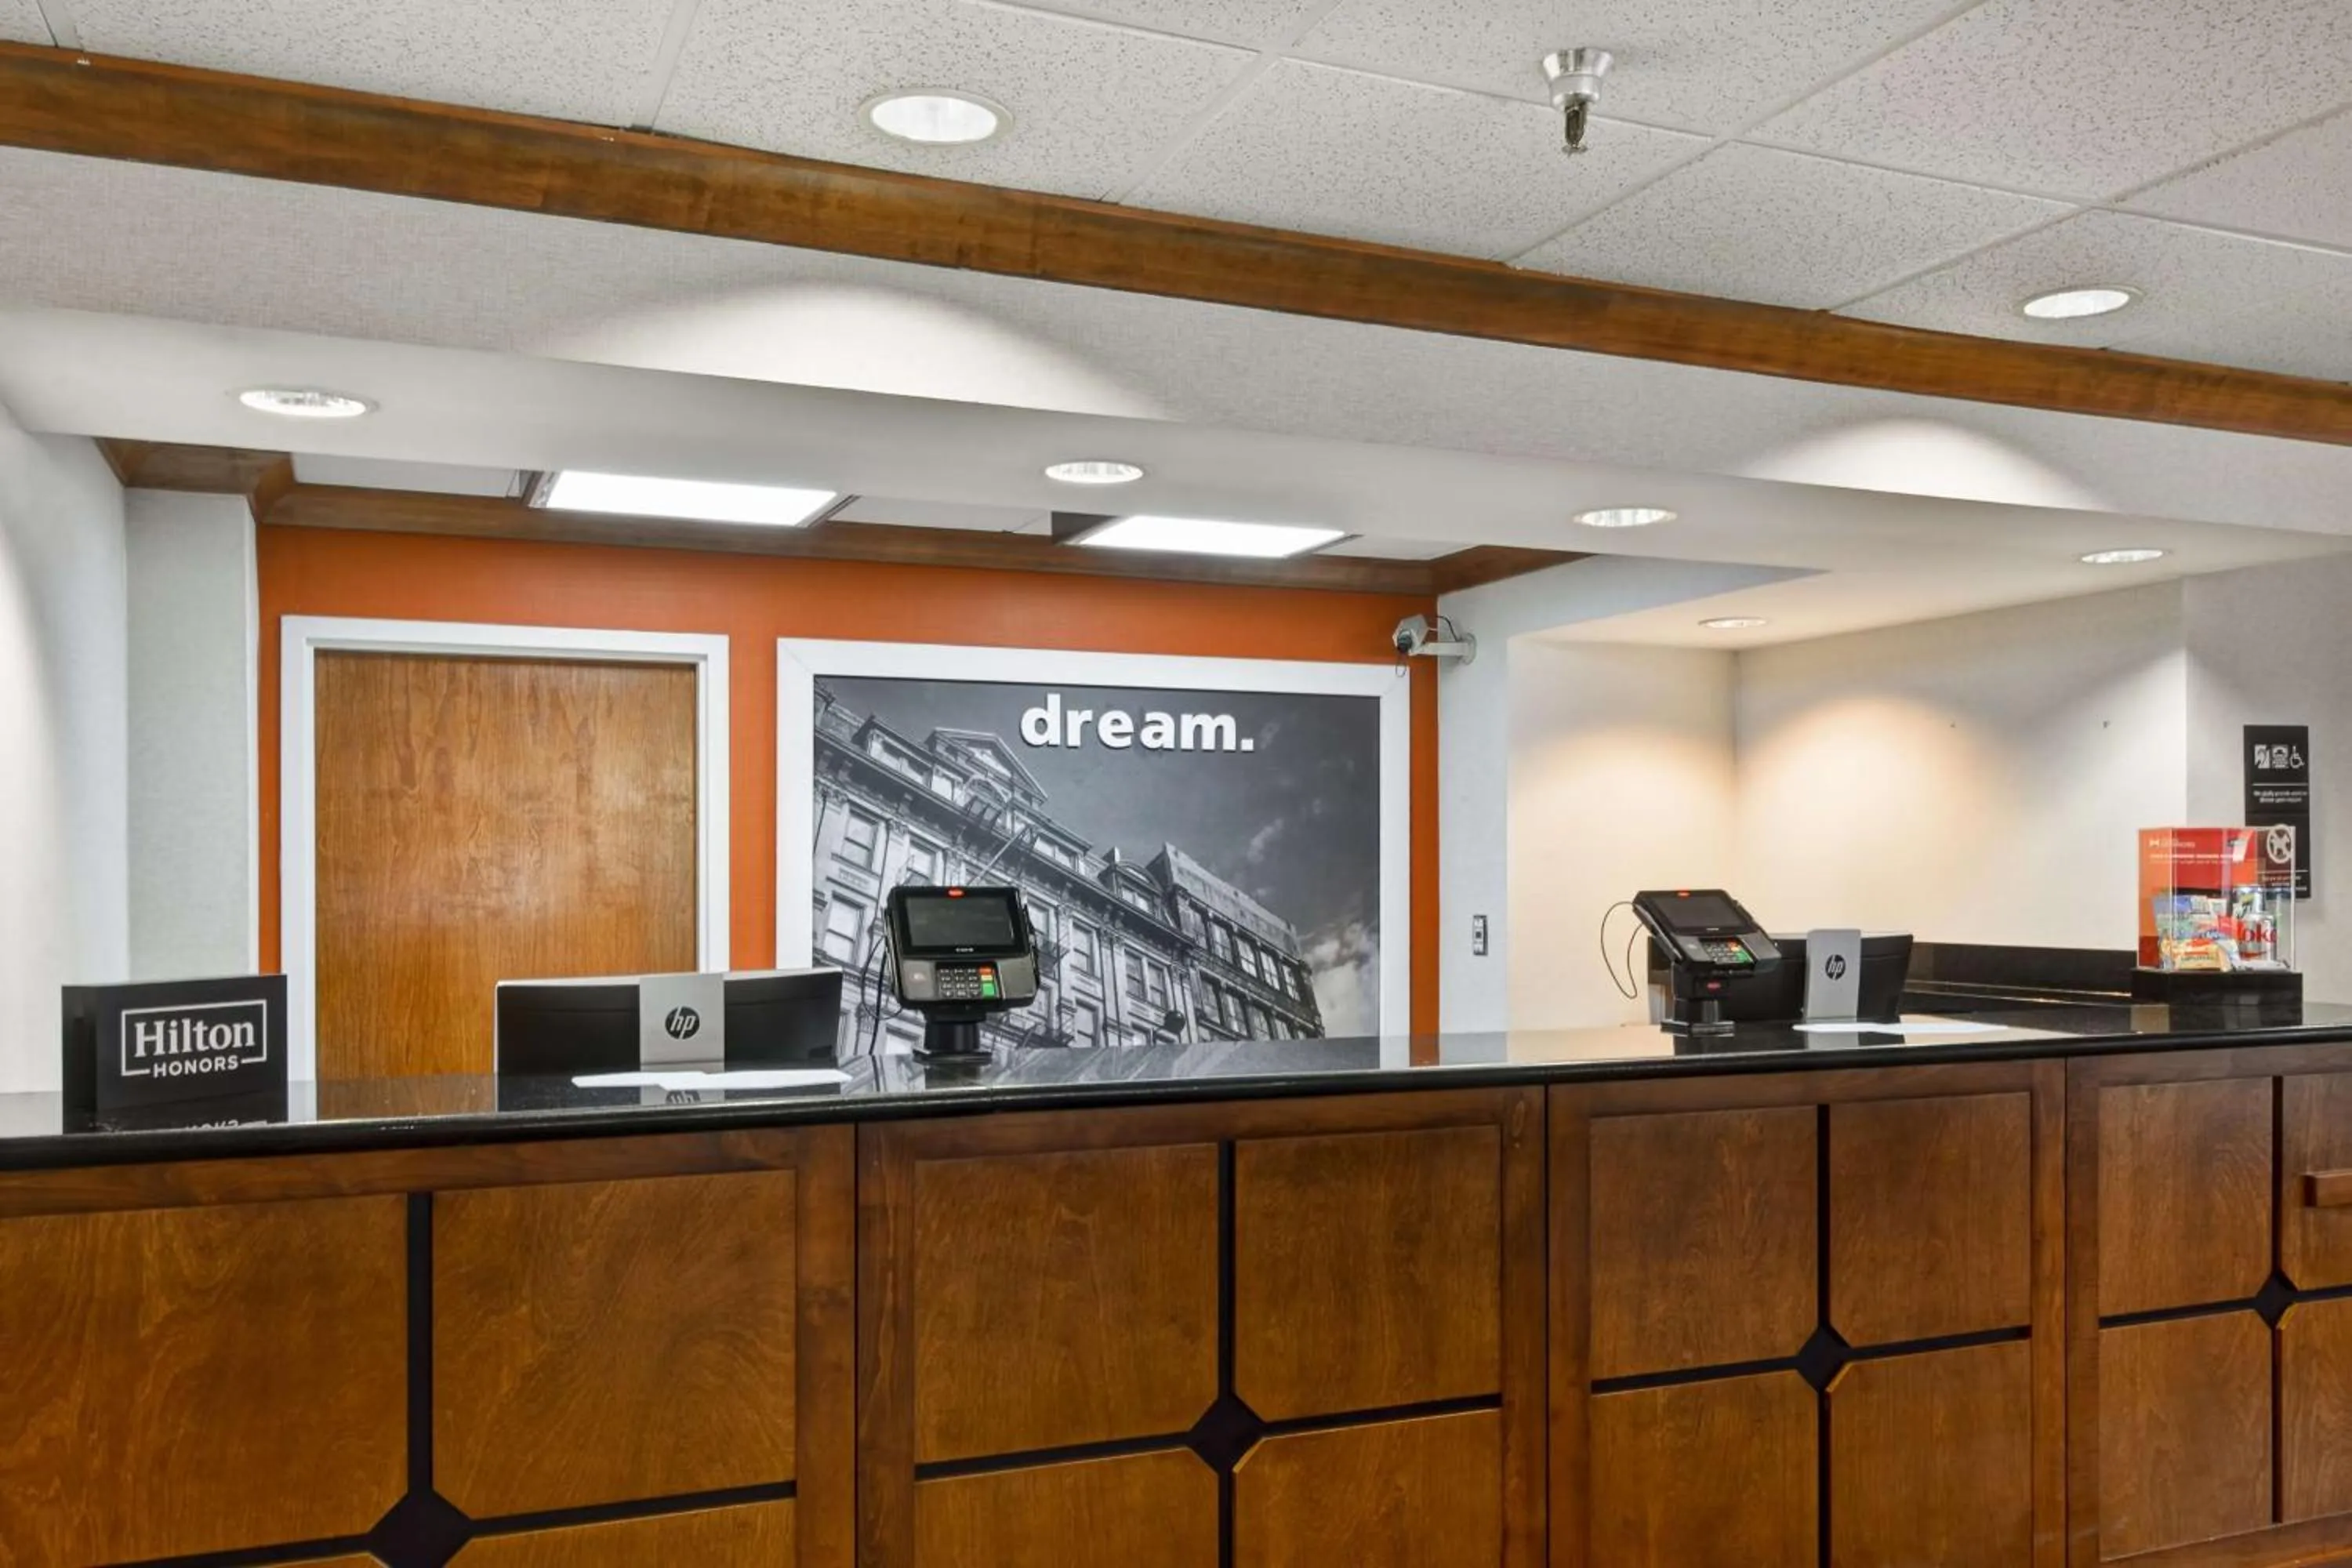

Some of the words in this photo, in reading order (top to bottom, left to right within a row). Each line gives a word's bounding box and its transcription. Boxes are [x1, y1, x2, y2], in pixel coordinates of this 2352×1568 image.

[1021, 693, 1254, 751] dream.
[1828, 954, 1844, 980] hp
[134, 1018, 255, 1057] Hilton
[670, 1005, 697, 1040] hp
[153, 1055, 238, 1078] HONORS
